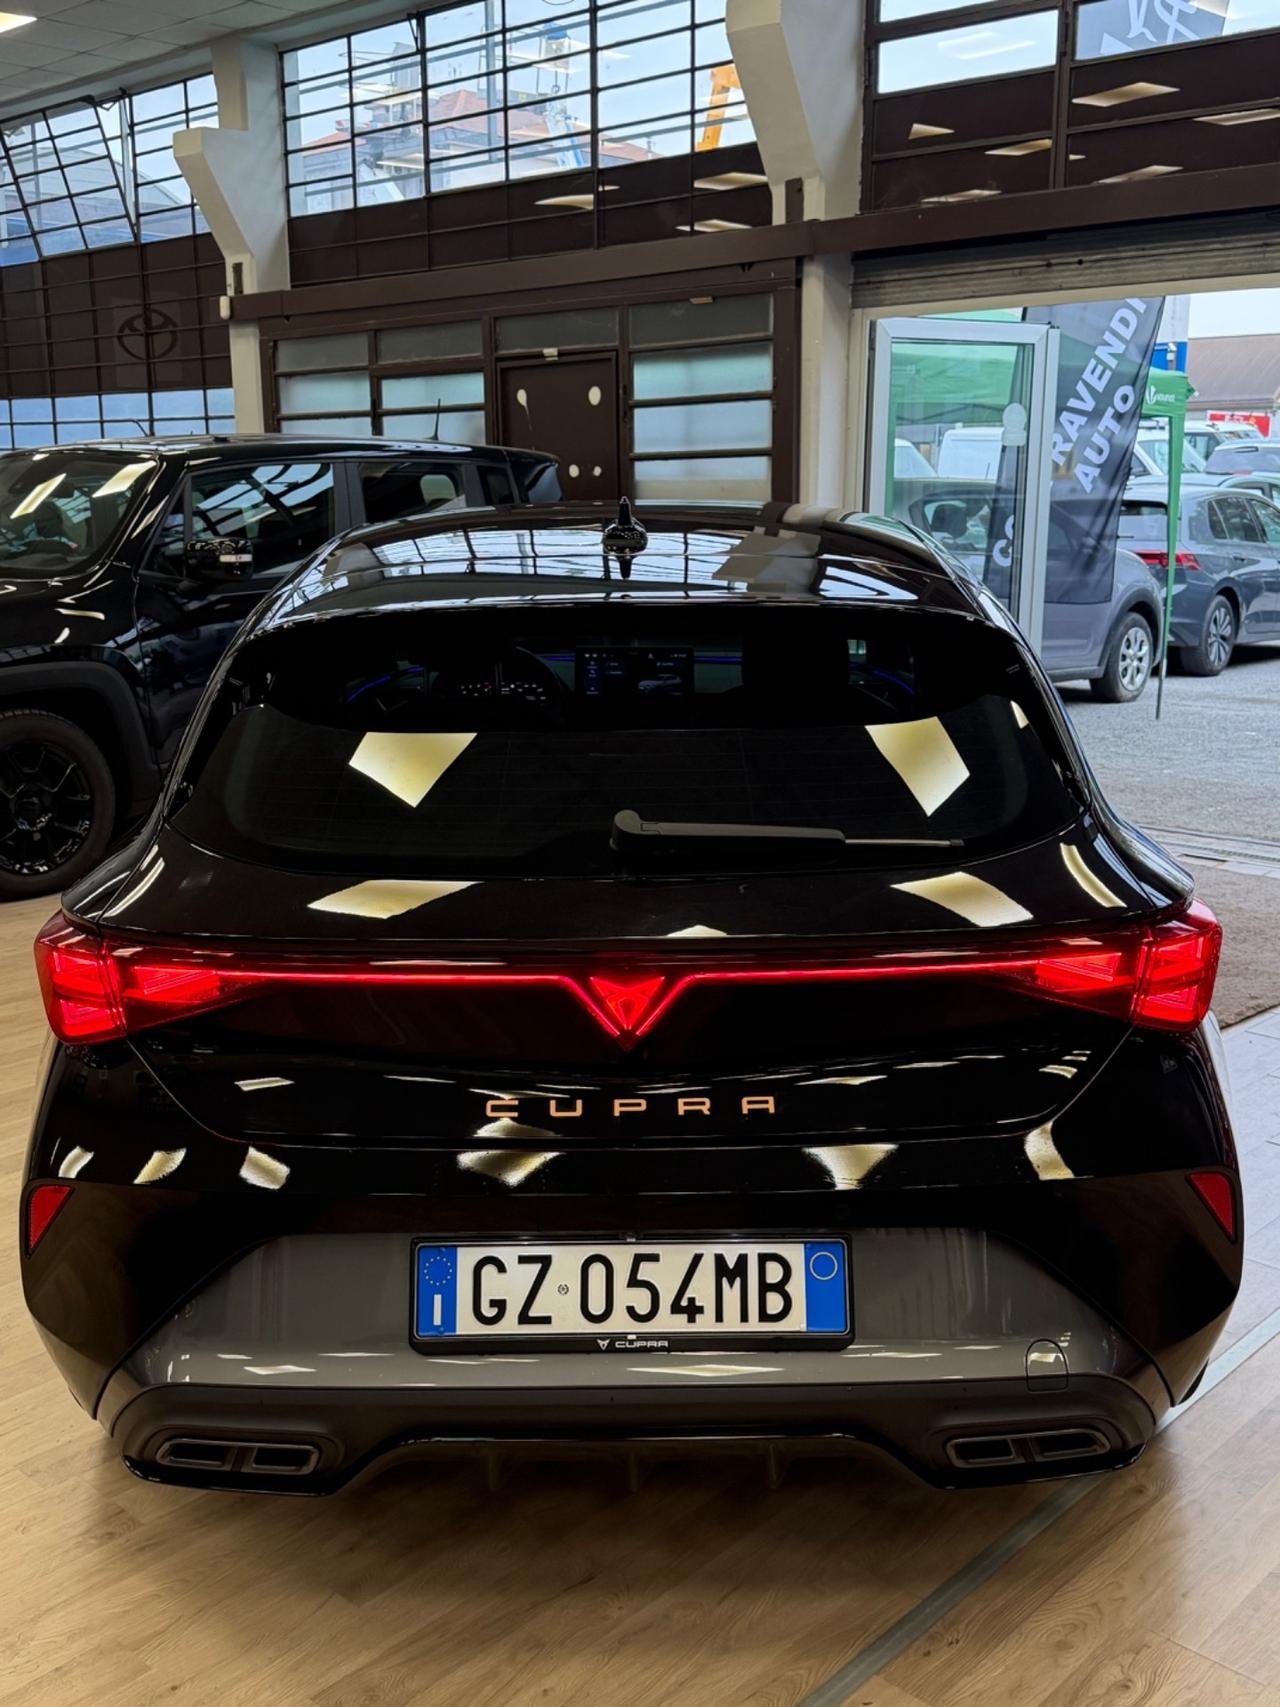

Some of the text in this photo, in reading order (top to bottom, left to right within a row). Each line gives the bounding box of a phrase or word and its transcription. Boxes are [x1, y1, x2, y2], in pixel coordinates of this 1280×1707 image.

[1074, 384, 1136, 494] AUTO
[485, 1095, 776, 1118] CUPRA
[615, 1340, 669, 1349] CUPRA
